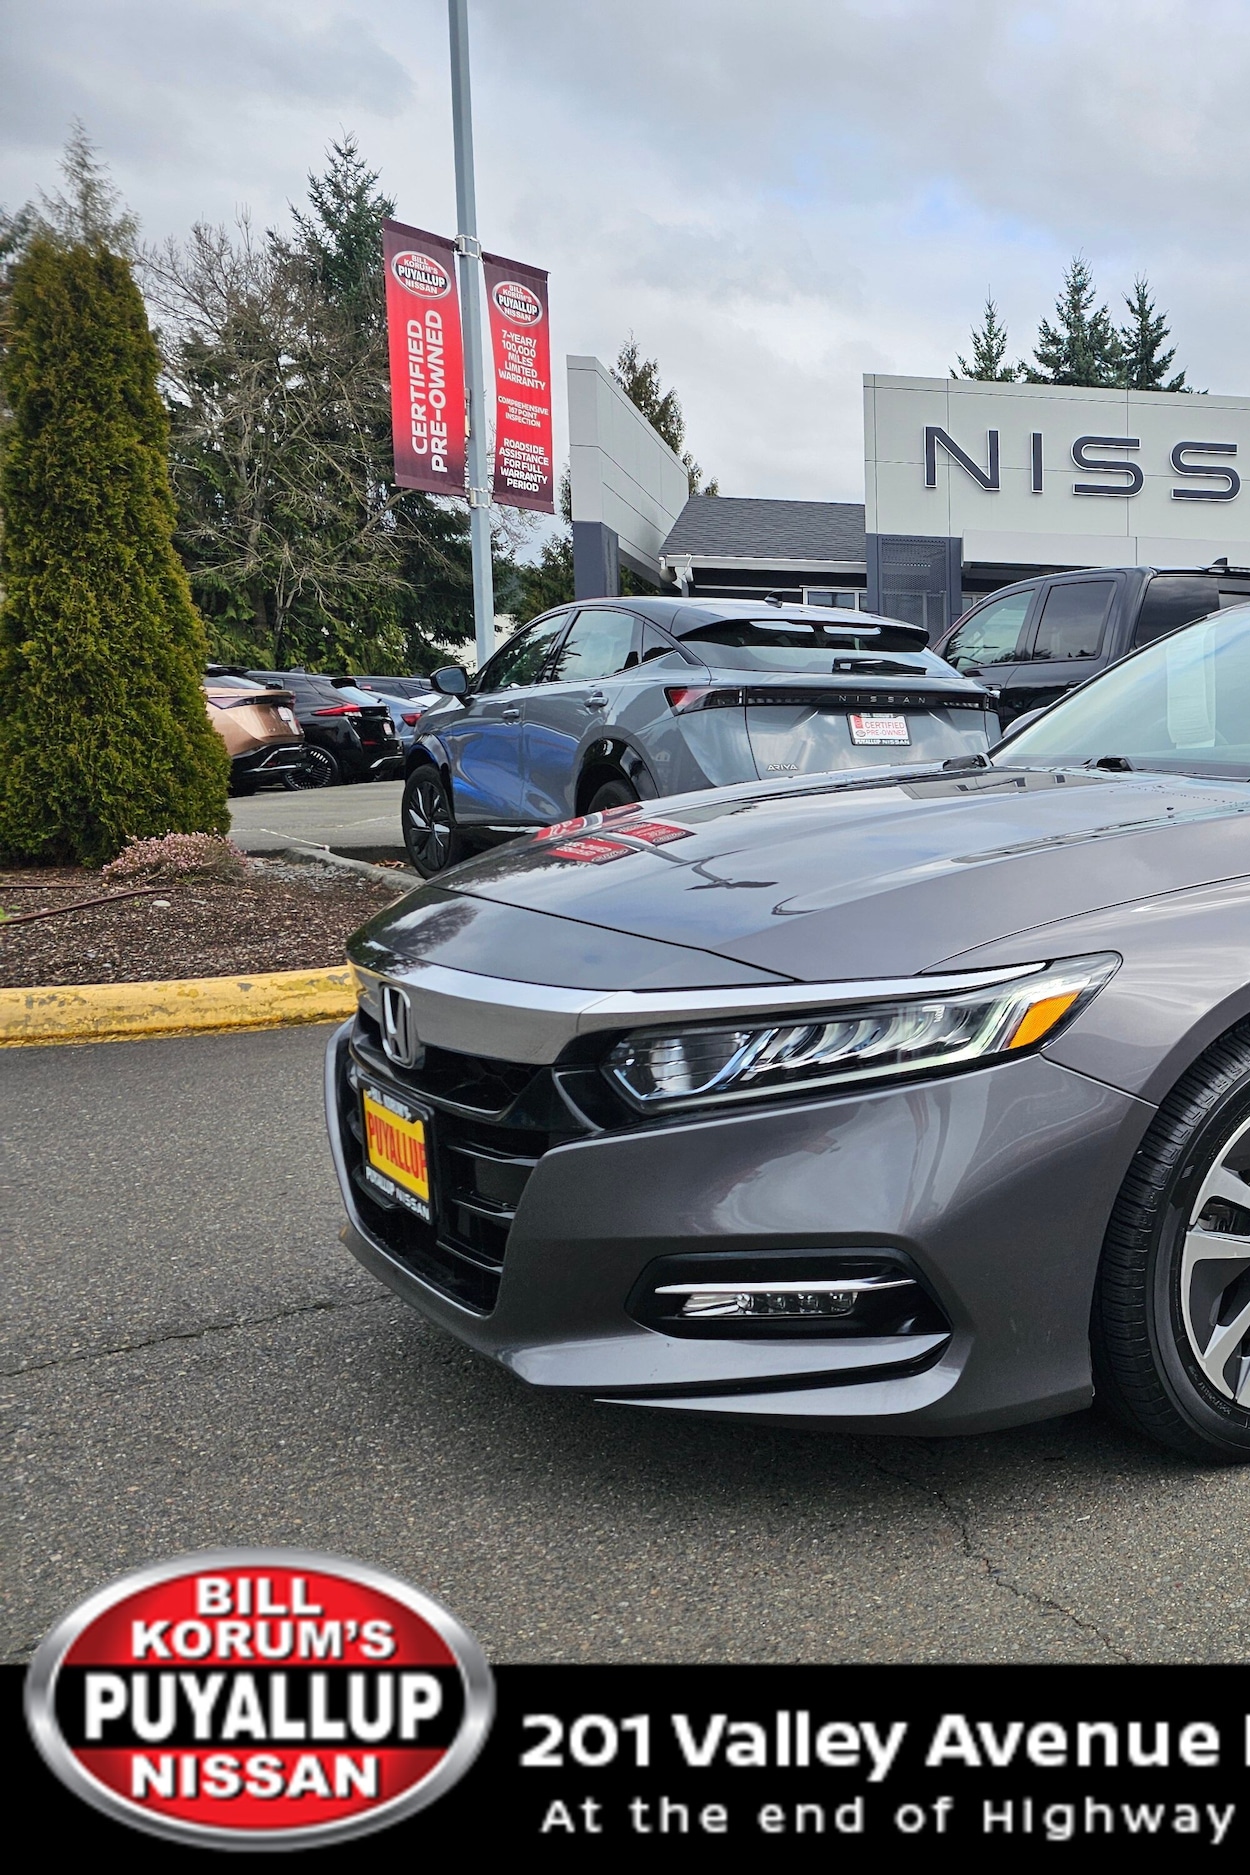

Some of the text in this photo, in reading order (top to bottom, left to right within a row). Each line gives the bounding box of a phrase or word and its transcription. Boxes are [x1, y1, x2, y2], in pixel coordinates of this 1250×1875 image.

[411, 255, 429, 265] BILL
[398, 265, 445, 287] PUYALLUP
[405, 279, 438, 294] NISSAN
[499, 295, 538, 315] PUYALLUP
[504, 307, 531, 321] NISSAN
[501, 330, 537, 348] 7-YEAR/
[502, 340, 536, 358] 100,000
[508, 352, 533, 367] MILES
[504, 361, 537, 378] LIMITED
[407, 319, 428, 455] CERTIFIED
[498, 369, 546, 390] WARRANTY
[425, 310, 447, 473] PRE-OWNED
[498, 396, 549, 415] COMPREHENSIVE
[518, 408, 537, 419] POINT
[505, 414, 541, 428] INSPECTION
[503, 438, 544, 456] ROADSIDE
[499, 447, 549, 466] ASSISTANCE
[504, 458, 542, 474] FOR FULL
[500, 467, 548, 485] WARRANTY
[507, 479, 539, 492] PERIOD
[838, 695, 926, 704] NISSAN
[767, 763, 798, 771] ARIYA
[396, 1187, 430, 1221] NISSAN
